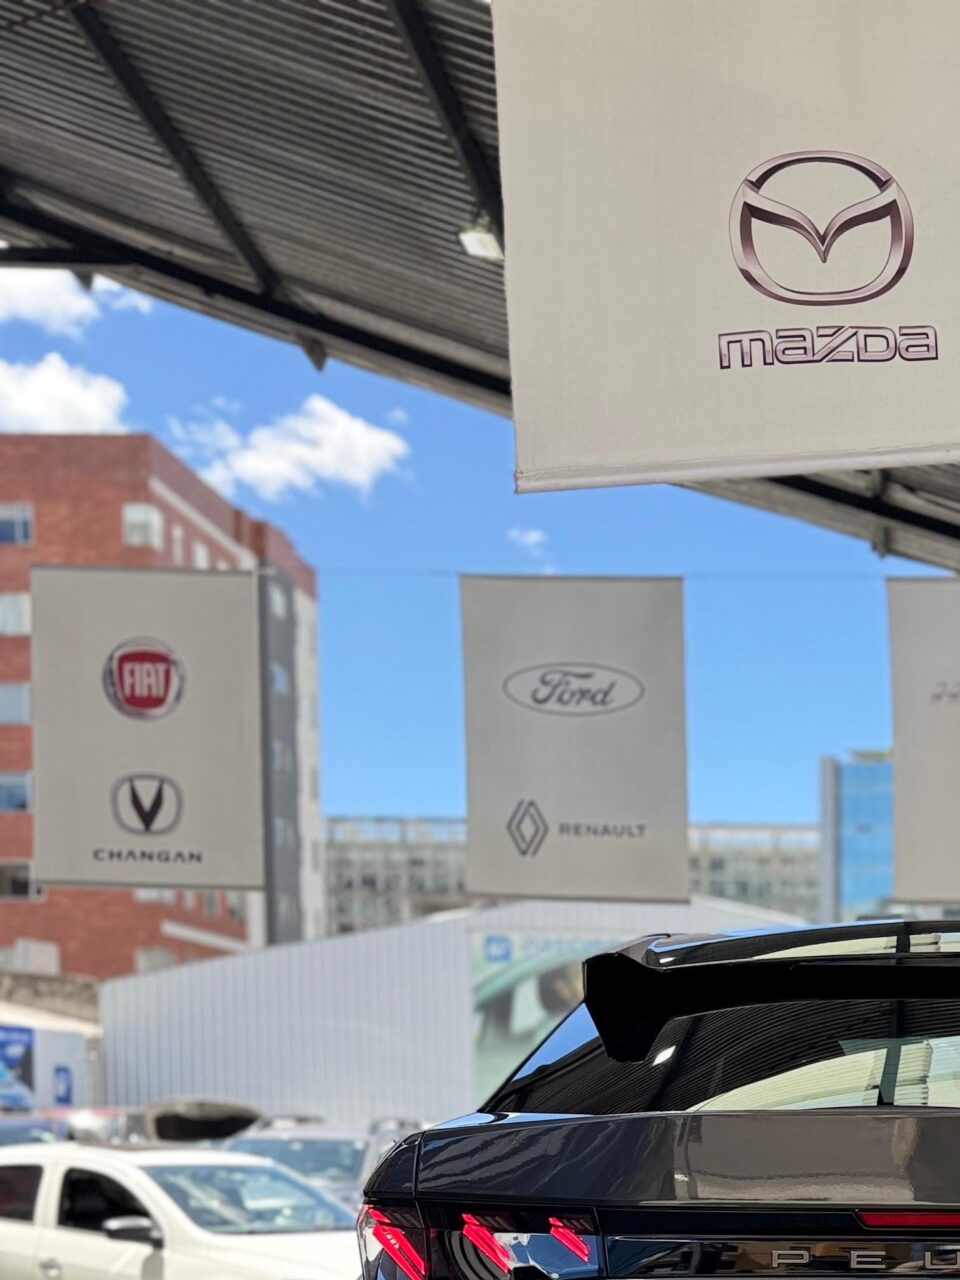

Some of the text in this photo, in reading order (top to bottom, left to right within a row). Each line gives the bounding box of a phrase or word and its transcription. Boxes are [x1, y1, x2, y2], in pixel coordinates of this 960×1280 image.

[122, 662, 169, 698] FIAT
[531, 669, 617, 707] Ford
[558, 822, 647, 838] RENAULT
[92, 848, 203, 864] CHANGAN
